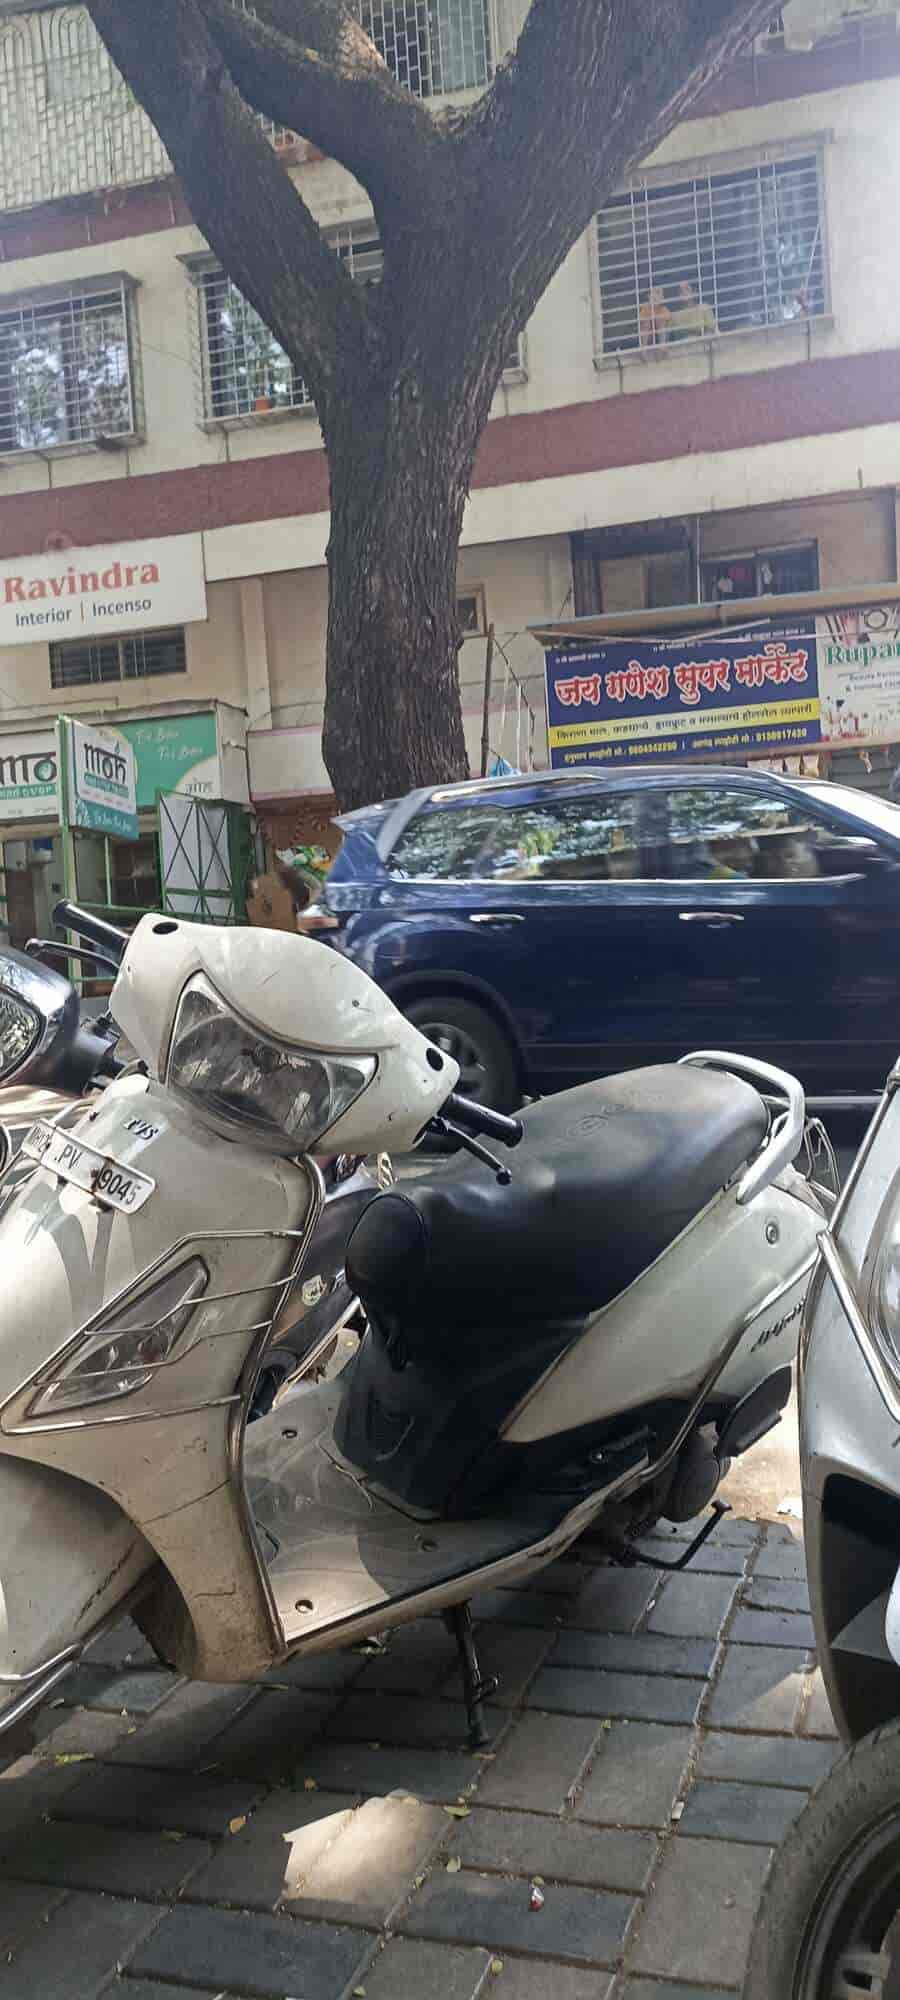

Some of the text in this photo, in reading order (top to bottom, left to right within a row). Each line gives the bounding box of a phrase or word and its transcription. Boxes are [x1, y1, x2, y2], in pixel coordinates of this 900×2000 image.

[4, 560, 161, 603] Ravindra
[15, 608, 72, 627] Interior
[825, 642, 900, 667] Rupa
[554, 675, 601, 705] जय
[605, 660, 671, 702] गणेश
[735, 642, 809, 688] मार्केट
[99, 1169, 142, 1205] 9045
